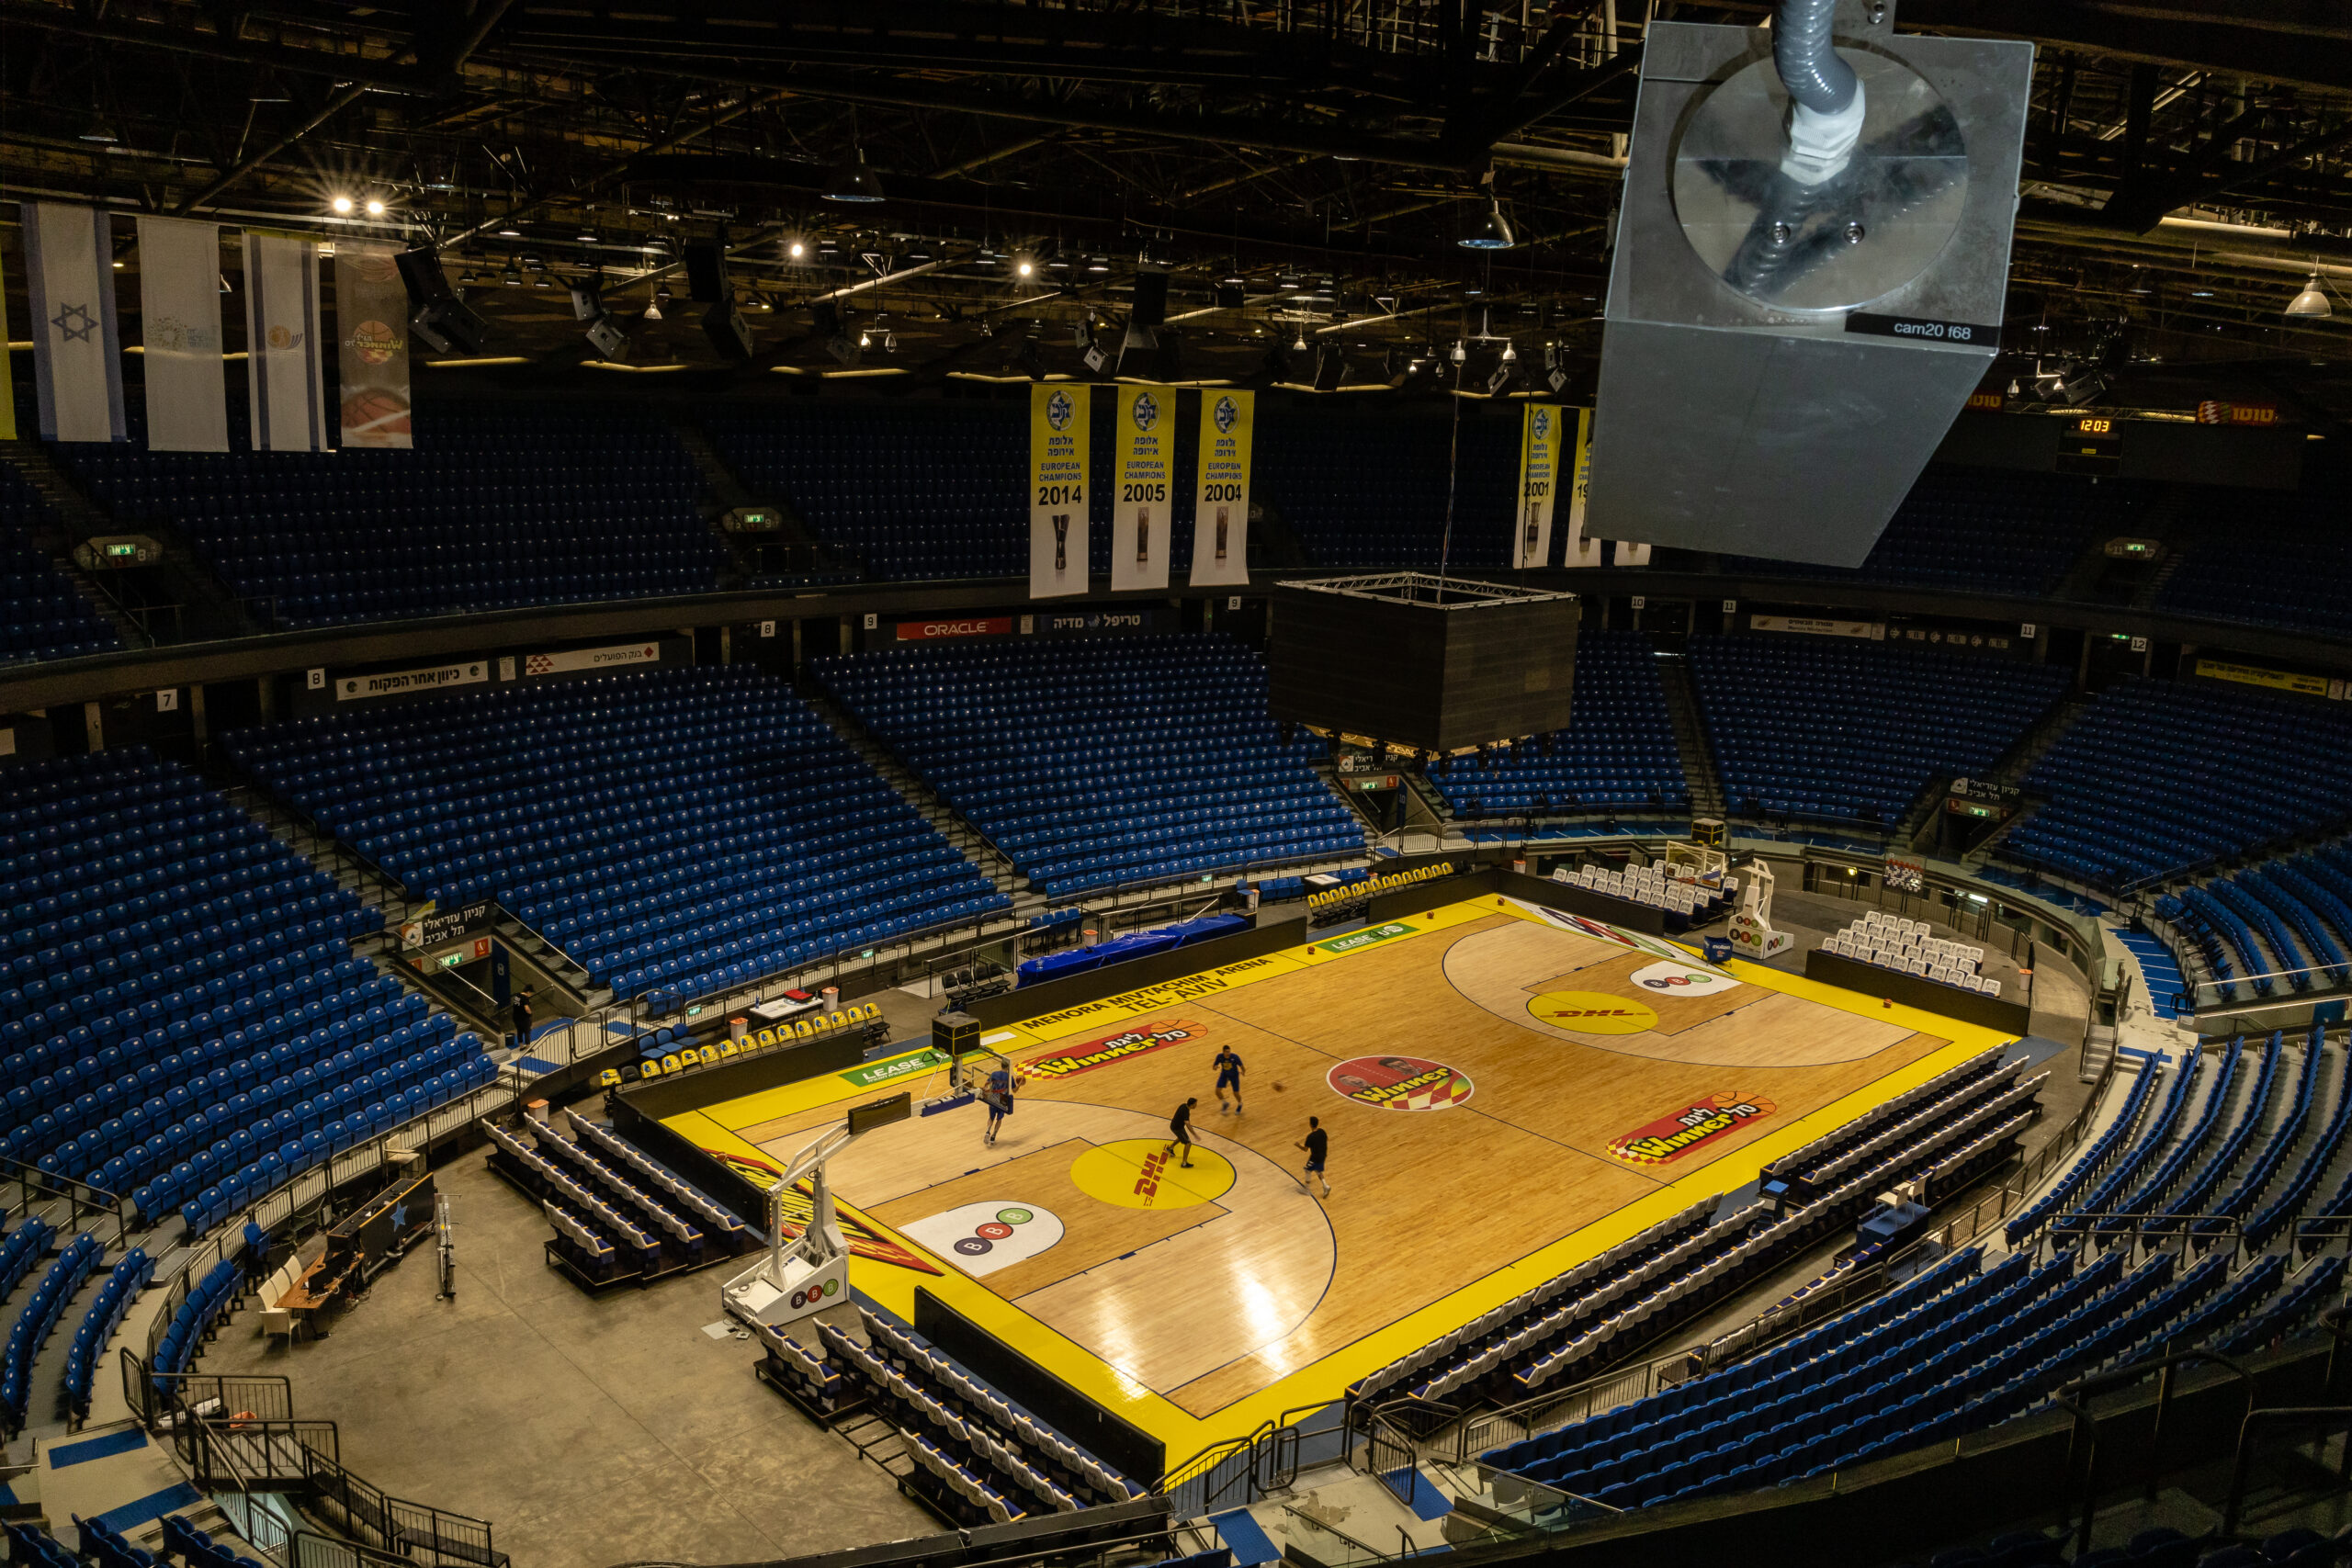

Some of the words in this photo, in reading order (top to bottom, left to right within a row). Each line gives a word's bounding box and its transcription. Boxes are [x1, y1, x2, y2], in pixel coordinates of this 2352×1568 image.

[1894, 322, 1944, 337] cam20
[1048, 435, 1074, 446] אלופת
[1134, 435, 1159, 446] אלופת
[1047, 447, 1075, 457] אירופה
[1133, 446, 1159, 456] אירופה
[1040, 461, 1080, 471] EUROPEAN
[1126, 460, 1164, 470] EUROPEAN
[1038, 471, 1082, 481] CHAMPIONS
[1124, 470, 1166, 479] CHAMPIONS
[1038, 485, 1082, 505] 2014
[1123, 483, 1166, 502] 2005
[1204, 483, 1242, 502] 2004
[1523, 481, 1549, 497] 2001
[1633, 598, 1644, 607] 10
[1724, 602, 1734, 611] 11
[867, 616, 874, 626] 9
[1053, 617, 1084, 629] מדיה
[1102, 614, 1141, 627] טריפל
[764, 624, 772, 635] 8
[923, 621, 987, 637] ORACLE
[2023, 626, 2032, 636] 11
[2132, 639, 2145, 649] 12
[594, 651, 628, 662] הפועלים
[628, 649, 642, 660] בנק
[311, 671, 321, 685] 8
[414, 672, 435, 684] אחר
[437, 669, 460, 684] כיוון
[368, 675, 410, 692] הפקות
[162, 694, 172, 707] 7
[1969, 778, 1999, 791] עזריאלי
[1968, 789, 1986, 798] אביב
[1988, 791, 2000, 801] תל
[463, 905, 486, 922] קניון
[424, 911, 460, 931] עזריאלי
[450, 923, 465, 936] תל
[424, 930, 448, 945] אביב
[497, 963, 504, 976] 8
[1023, 1002, 1105, 1030] MENORA
[1105, 974, 1210, 1008] MIVTACHIM
[1215, 957, 1274, 977] ARENA
[1179, 978, 1229, 1000] AVIV
[1553, 1009, 1634, 1018] DHL
[1104, 1032, 1144, 1050] ליגת
[1152, 1028, 1190, 1043] סל
[1039, 1037, 1158, 1075] Winner
[1351, 1066, 1450, 1102] Winner
[1678, 1107, 1715, 1127] ליגת
[1721, 1103, 1758, 1118] סל
[1627, 1112, 1734, 1157] Winner
[1133, 1151, 1169, 1198] DHL
